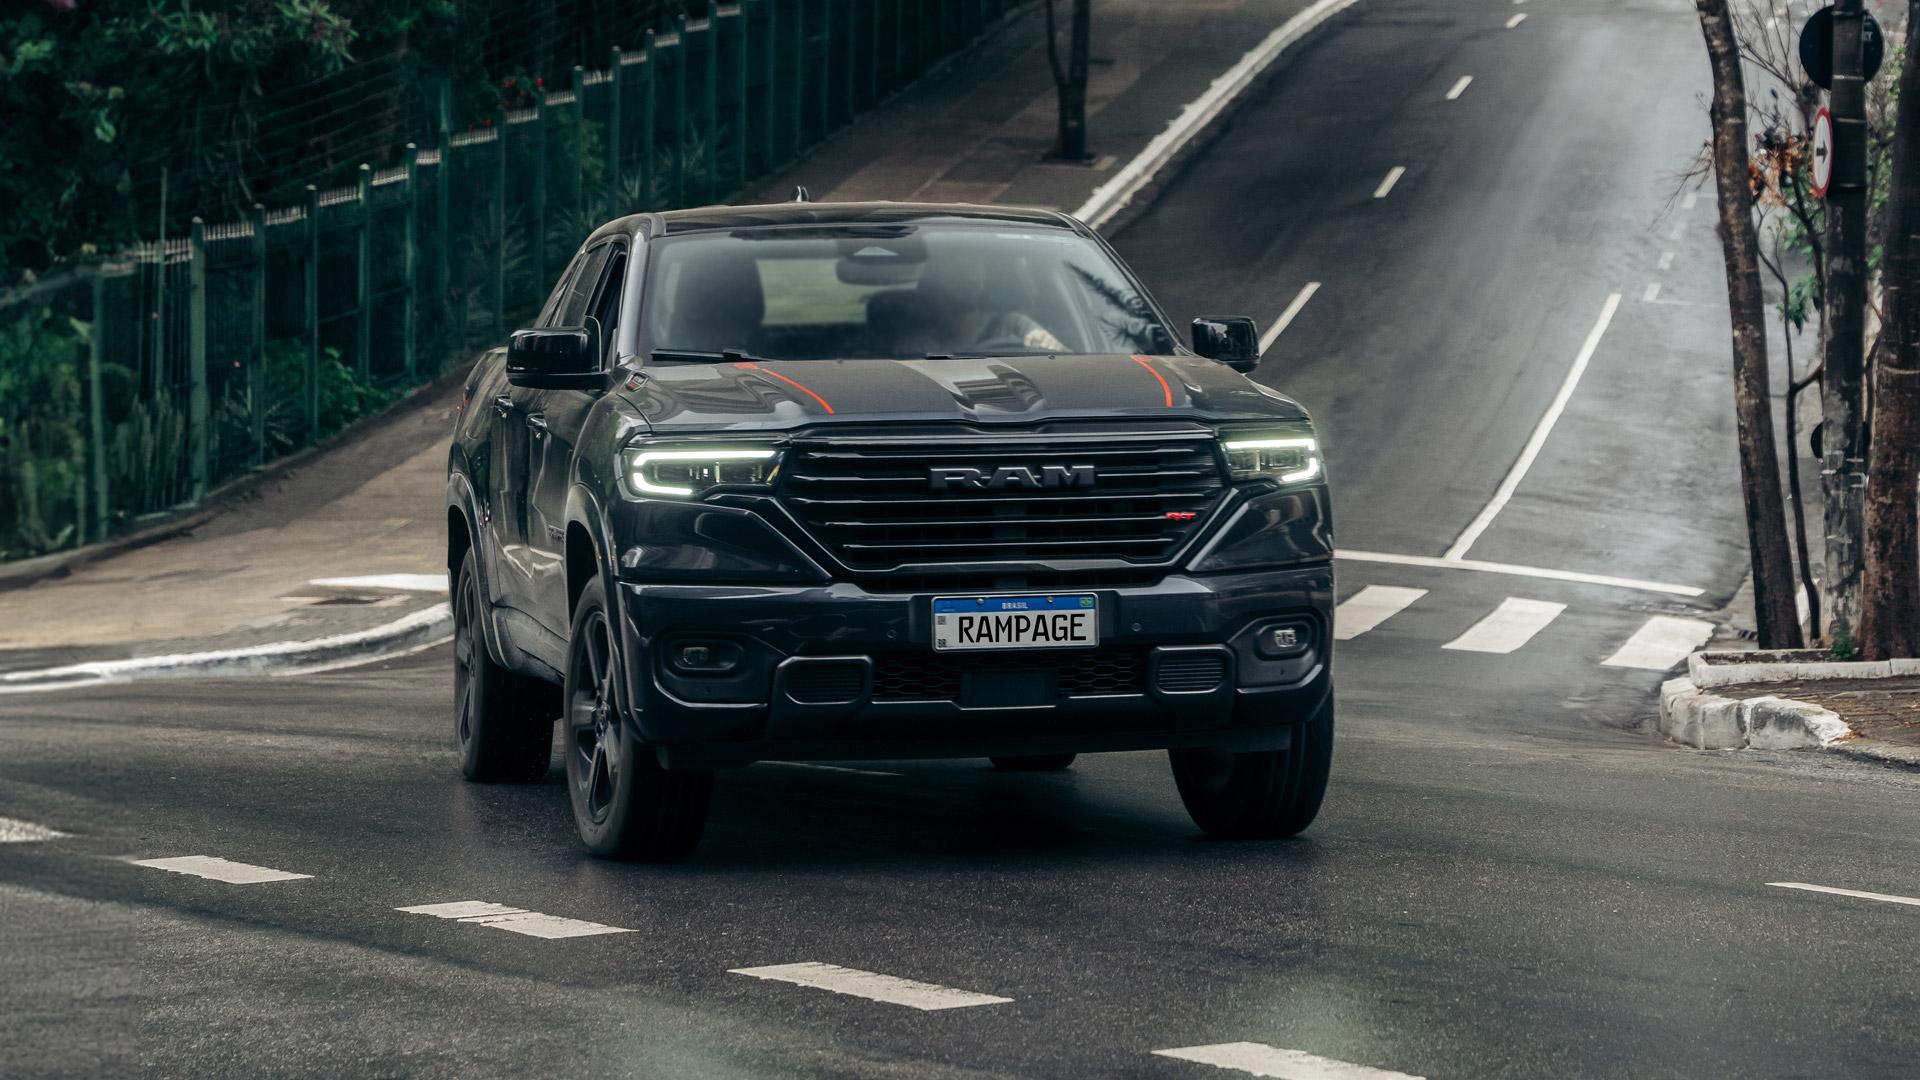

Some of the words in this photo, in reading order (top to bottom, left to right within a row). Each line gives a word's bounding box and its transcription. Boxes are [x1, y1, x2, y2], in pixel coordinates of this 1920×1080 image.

[930, 465, 1095, 488] RAM
[1001, 602, 1029, 610] BRASIL
[958, 613, 1087, 644] RAMPAGE
